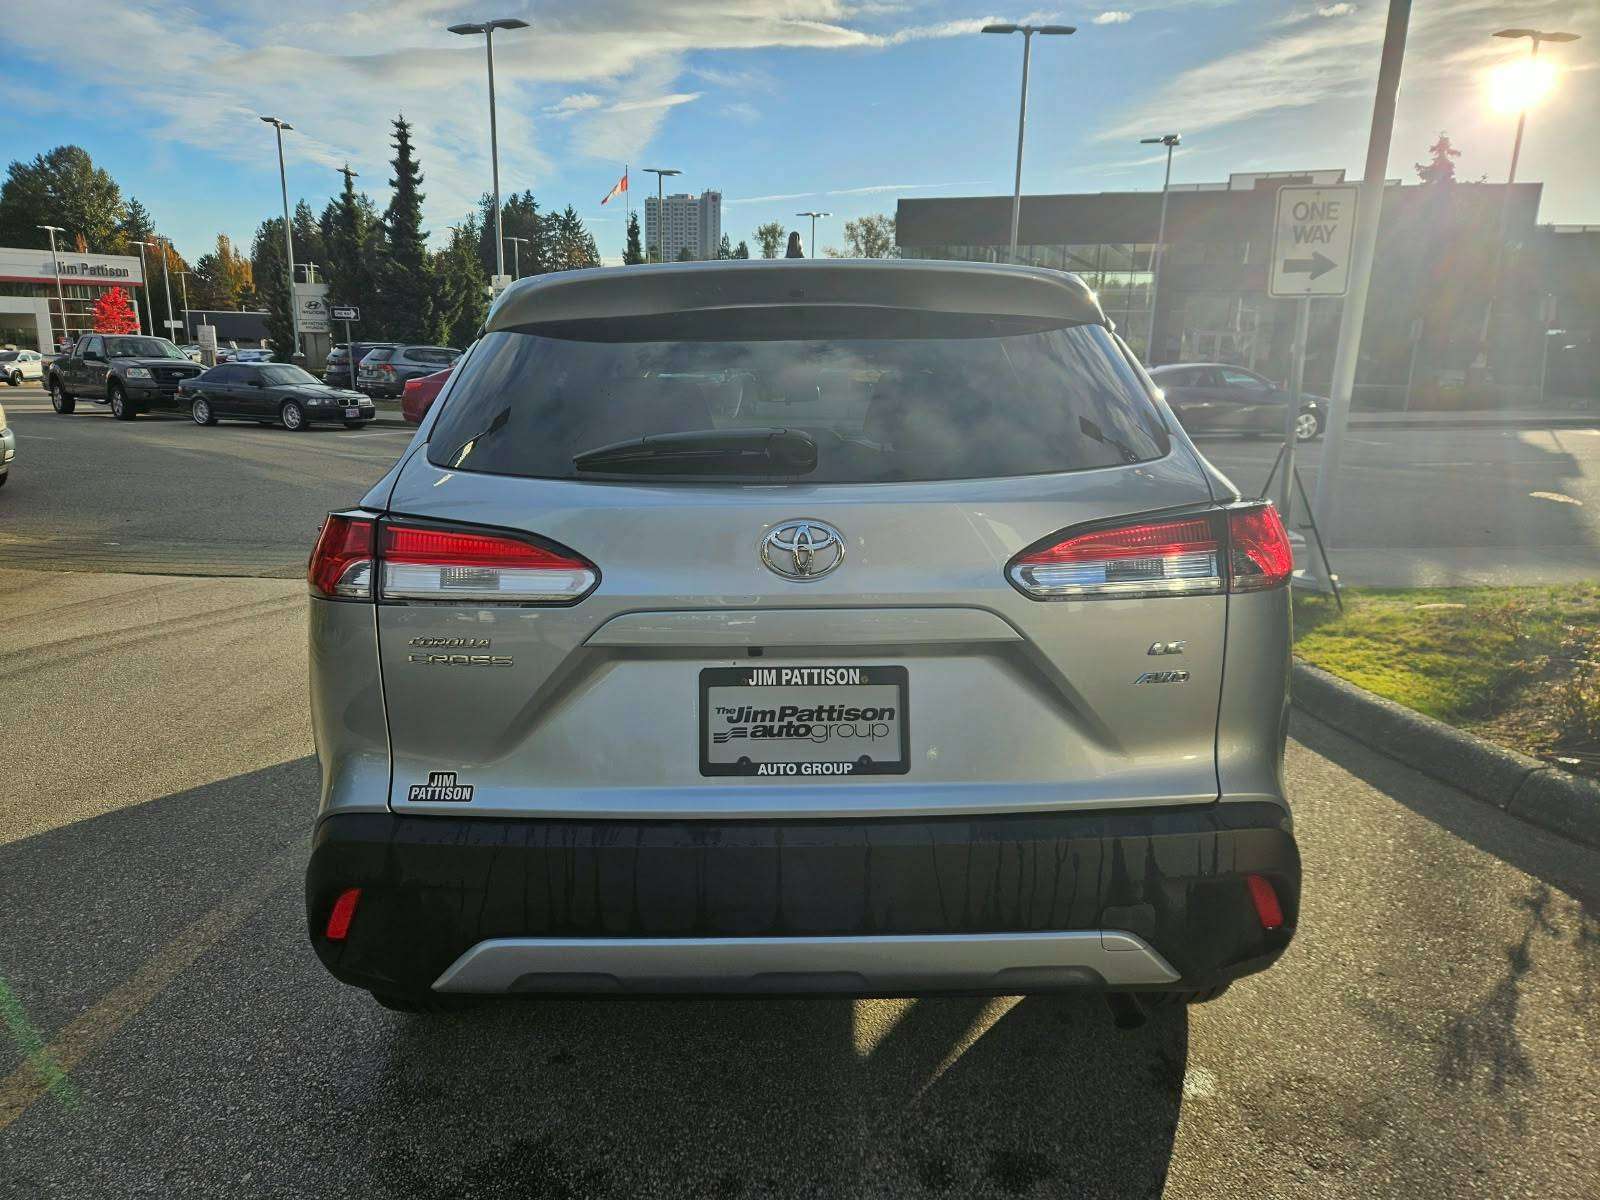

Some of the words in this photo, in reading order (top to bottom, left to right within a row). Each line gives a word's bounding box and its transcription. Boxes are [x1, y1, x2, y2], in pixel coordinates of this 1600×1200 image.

[1293, 201, 1340, 221] ONE
[1293, 224, 1337, 244] WAY
[57, 261, 77, 275] Jim
[81, 262, 129, 277] Pattison
[408, 637, 491, 648] COROLLA
[408, 653, 513, 666] CROSS
[749, 668, 777, 686] JIM
[782, 668, 861, 686] PATTISON
[714, 706, 736, 715] The
[726, 706, 777, 723] Jim
[778, 705, 896, 723] Pattison
[757, 763, 797, 776] AUTO
[801, 762, 853, 775] GROUP
[430, 774, 455, 787] JIM
[410, 786, 472, 800] PATTISON
